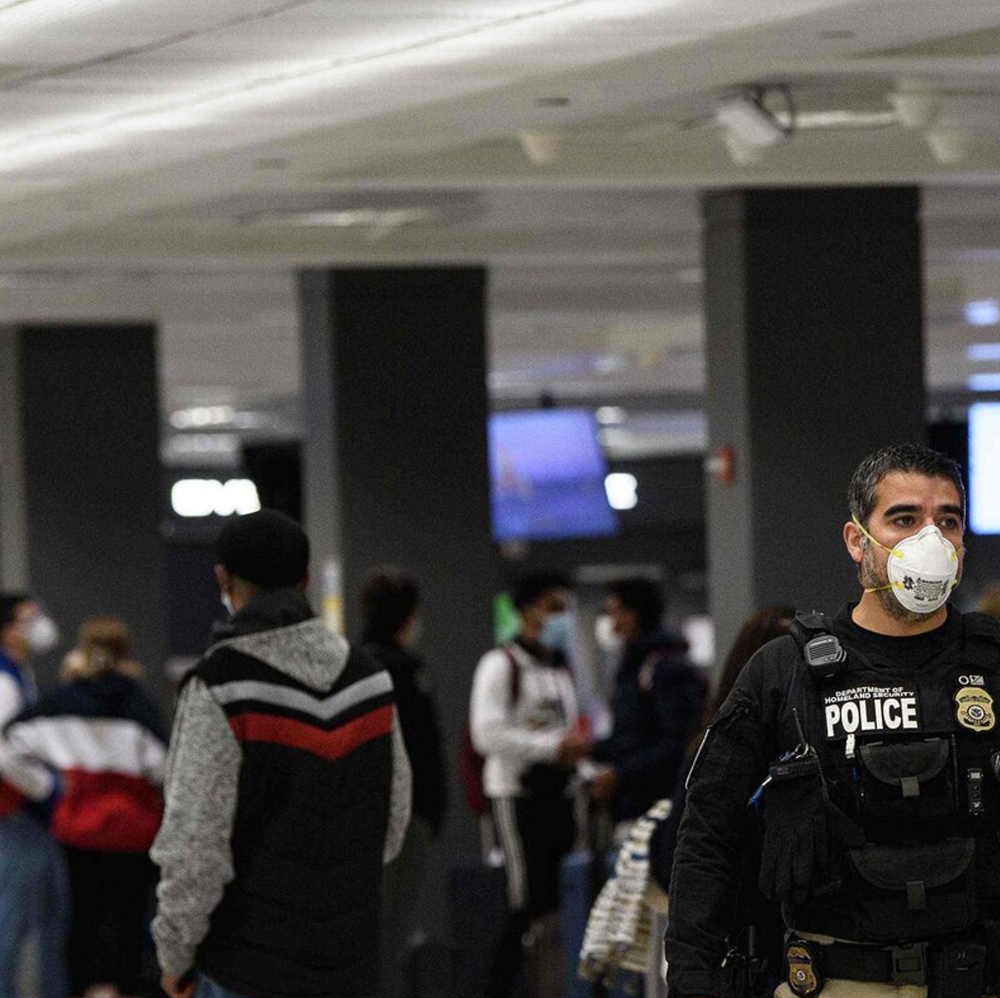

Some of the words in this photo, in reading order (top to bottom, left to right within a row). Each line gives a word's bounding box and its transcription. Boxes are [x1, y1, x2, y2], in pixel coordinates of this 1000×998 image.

[835, 686, 890, 697] DEPARTMENT
[825, 692, 871, 704] HOMELAND
[825, 698, 918, 737] POLICE
